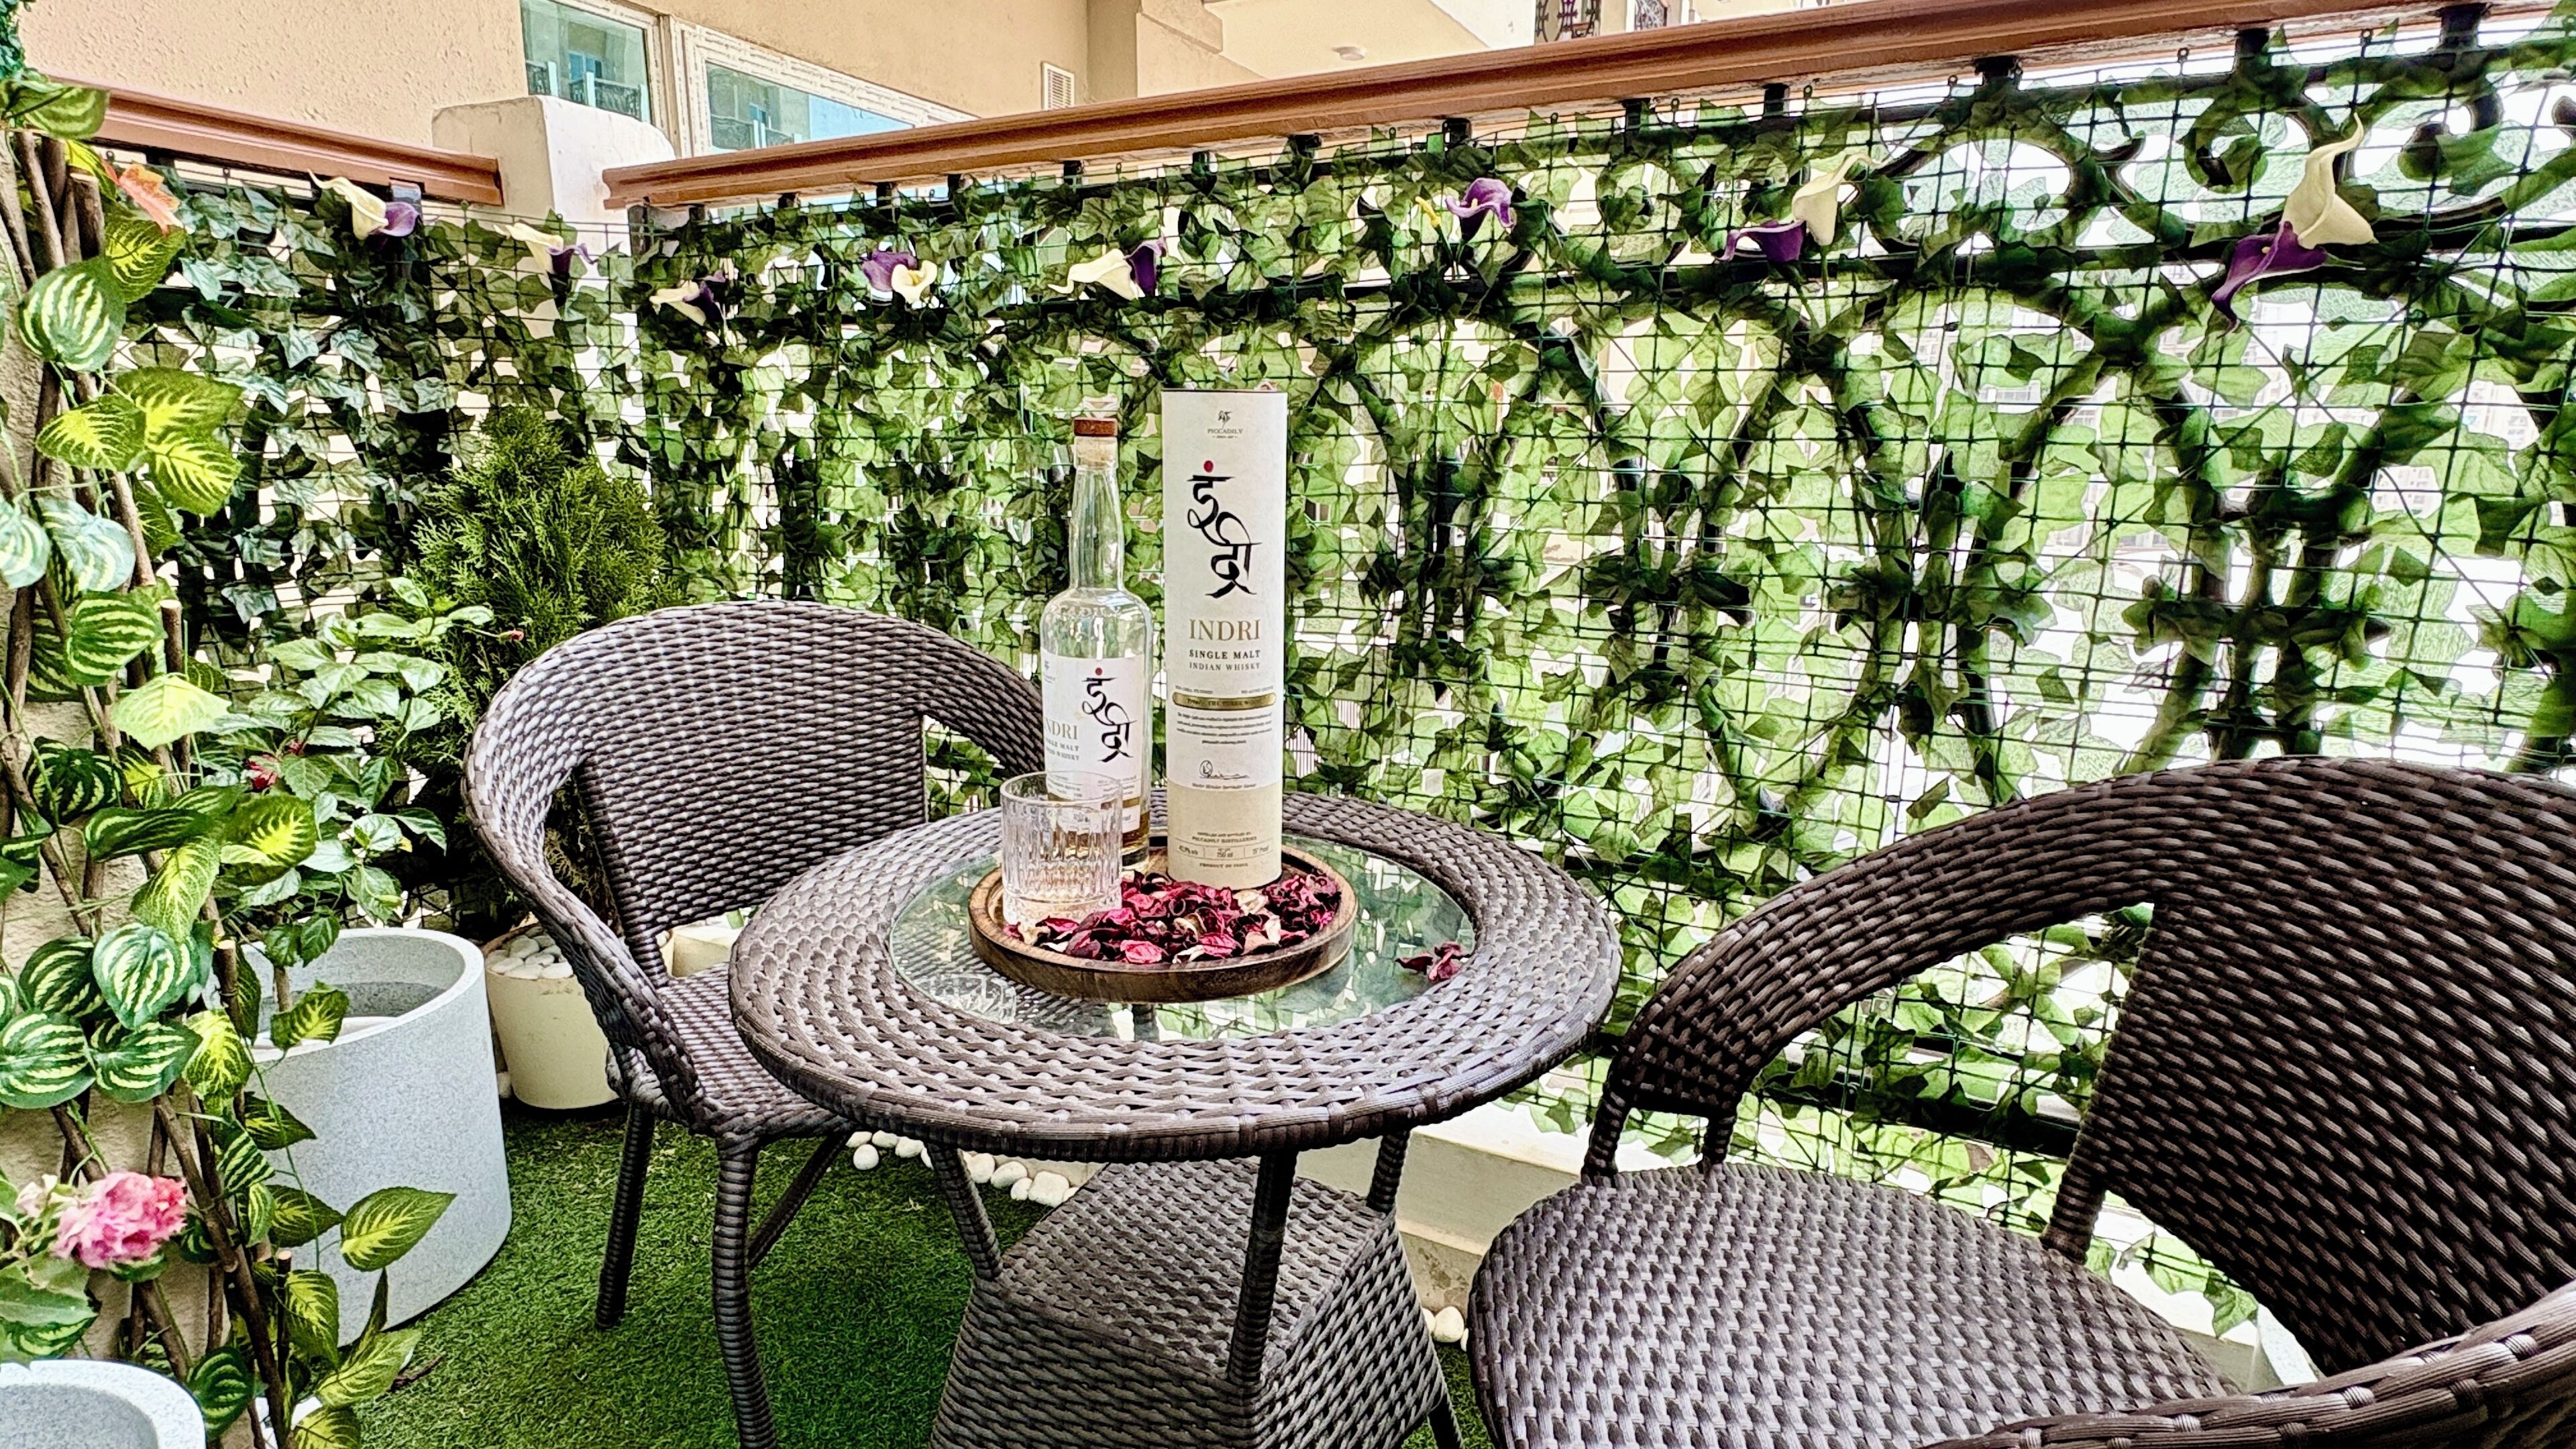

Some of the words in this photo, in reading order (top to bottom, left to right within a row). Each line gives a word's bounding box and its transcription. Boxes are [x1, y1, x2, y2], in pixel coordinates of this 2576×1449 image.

[1189, 619, 1260, 641] INDRI
[1189, 649, 1228, 660] SINGLE
[1233, 649, 1261, 660] MALT
[1189, 661, 1222, 672] INDIAN
[1226, 662, 1260, 672] WHISKY
